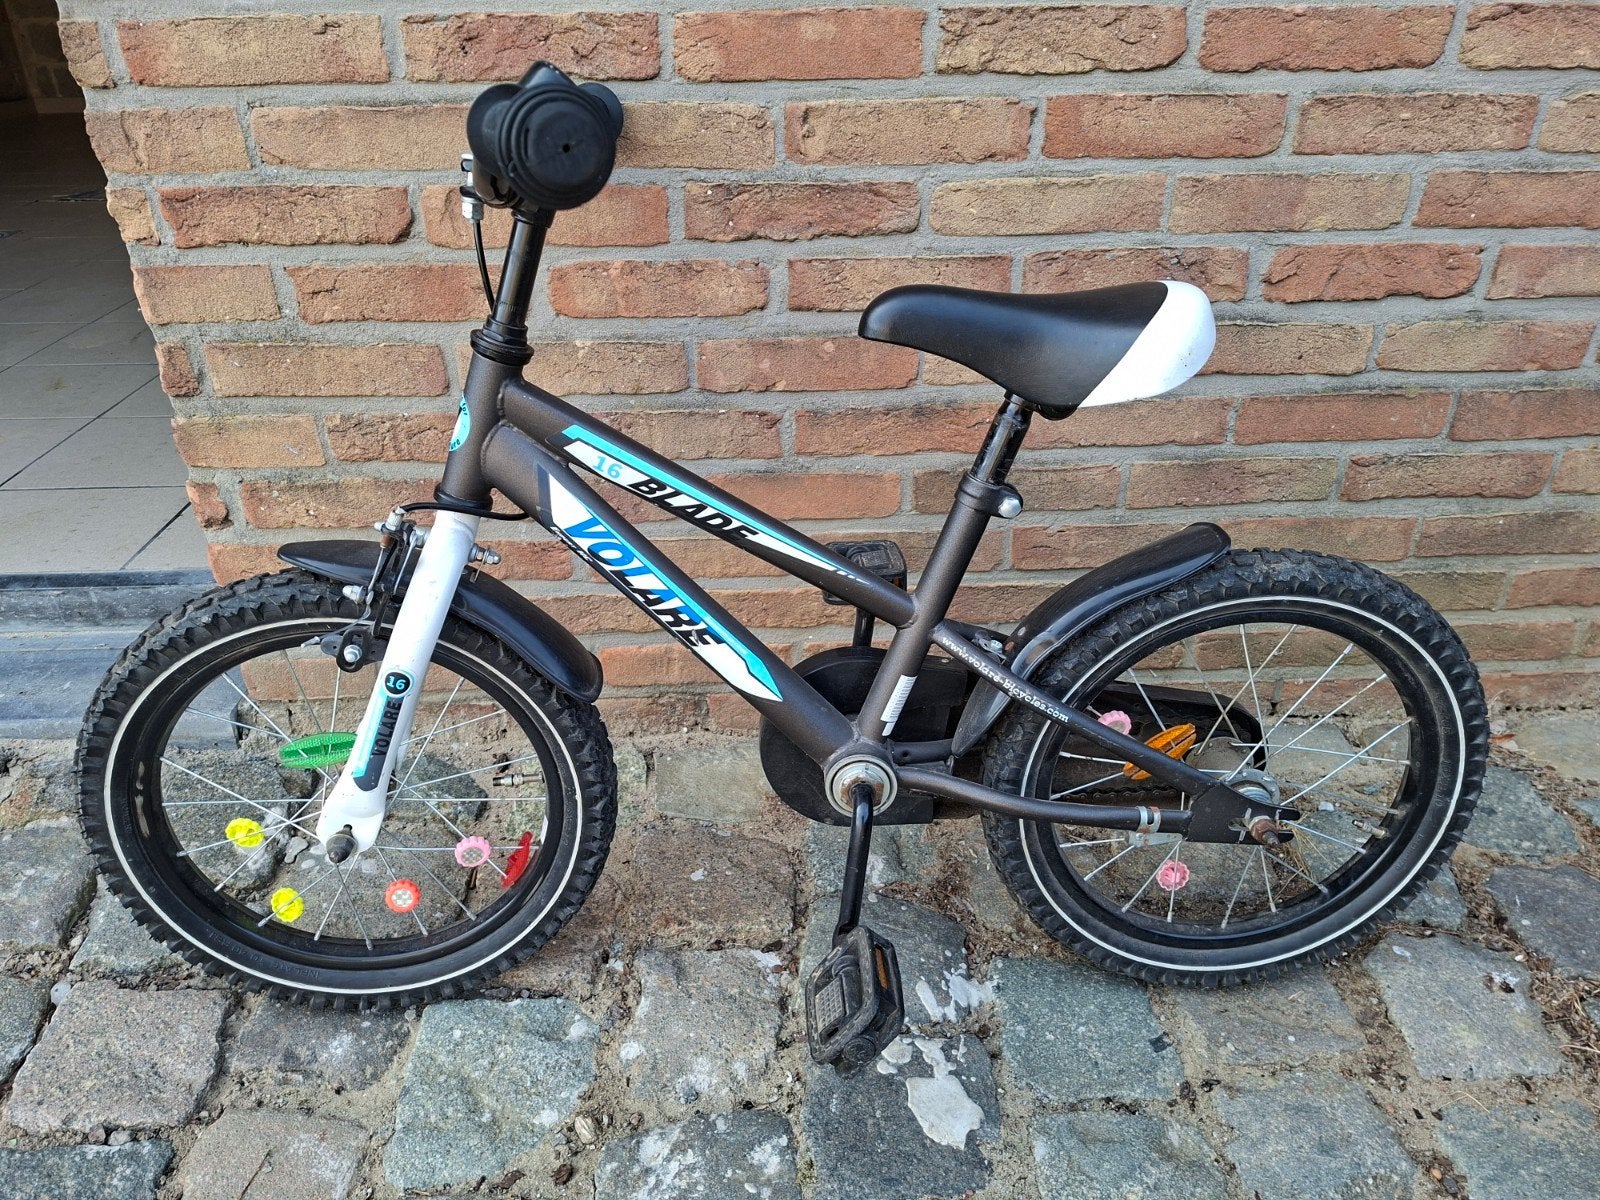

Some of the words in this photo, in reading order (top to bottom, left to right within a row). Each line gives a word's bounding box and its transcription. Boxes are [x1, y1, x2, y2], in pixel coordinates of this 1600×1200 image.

[592, 455, 622, 480] 16
[628, 477, 760, 541] BLADE
[564, 517, 726, 648] VOLARE
[386, 675, 406, 691] 16
[941, 637, 1070, 723] www.volare-bicycles.com
[371, 700, 402, 756] VOLARE
